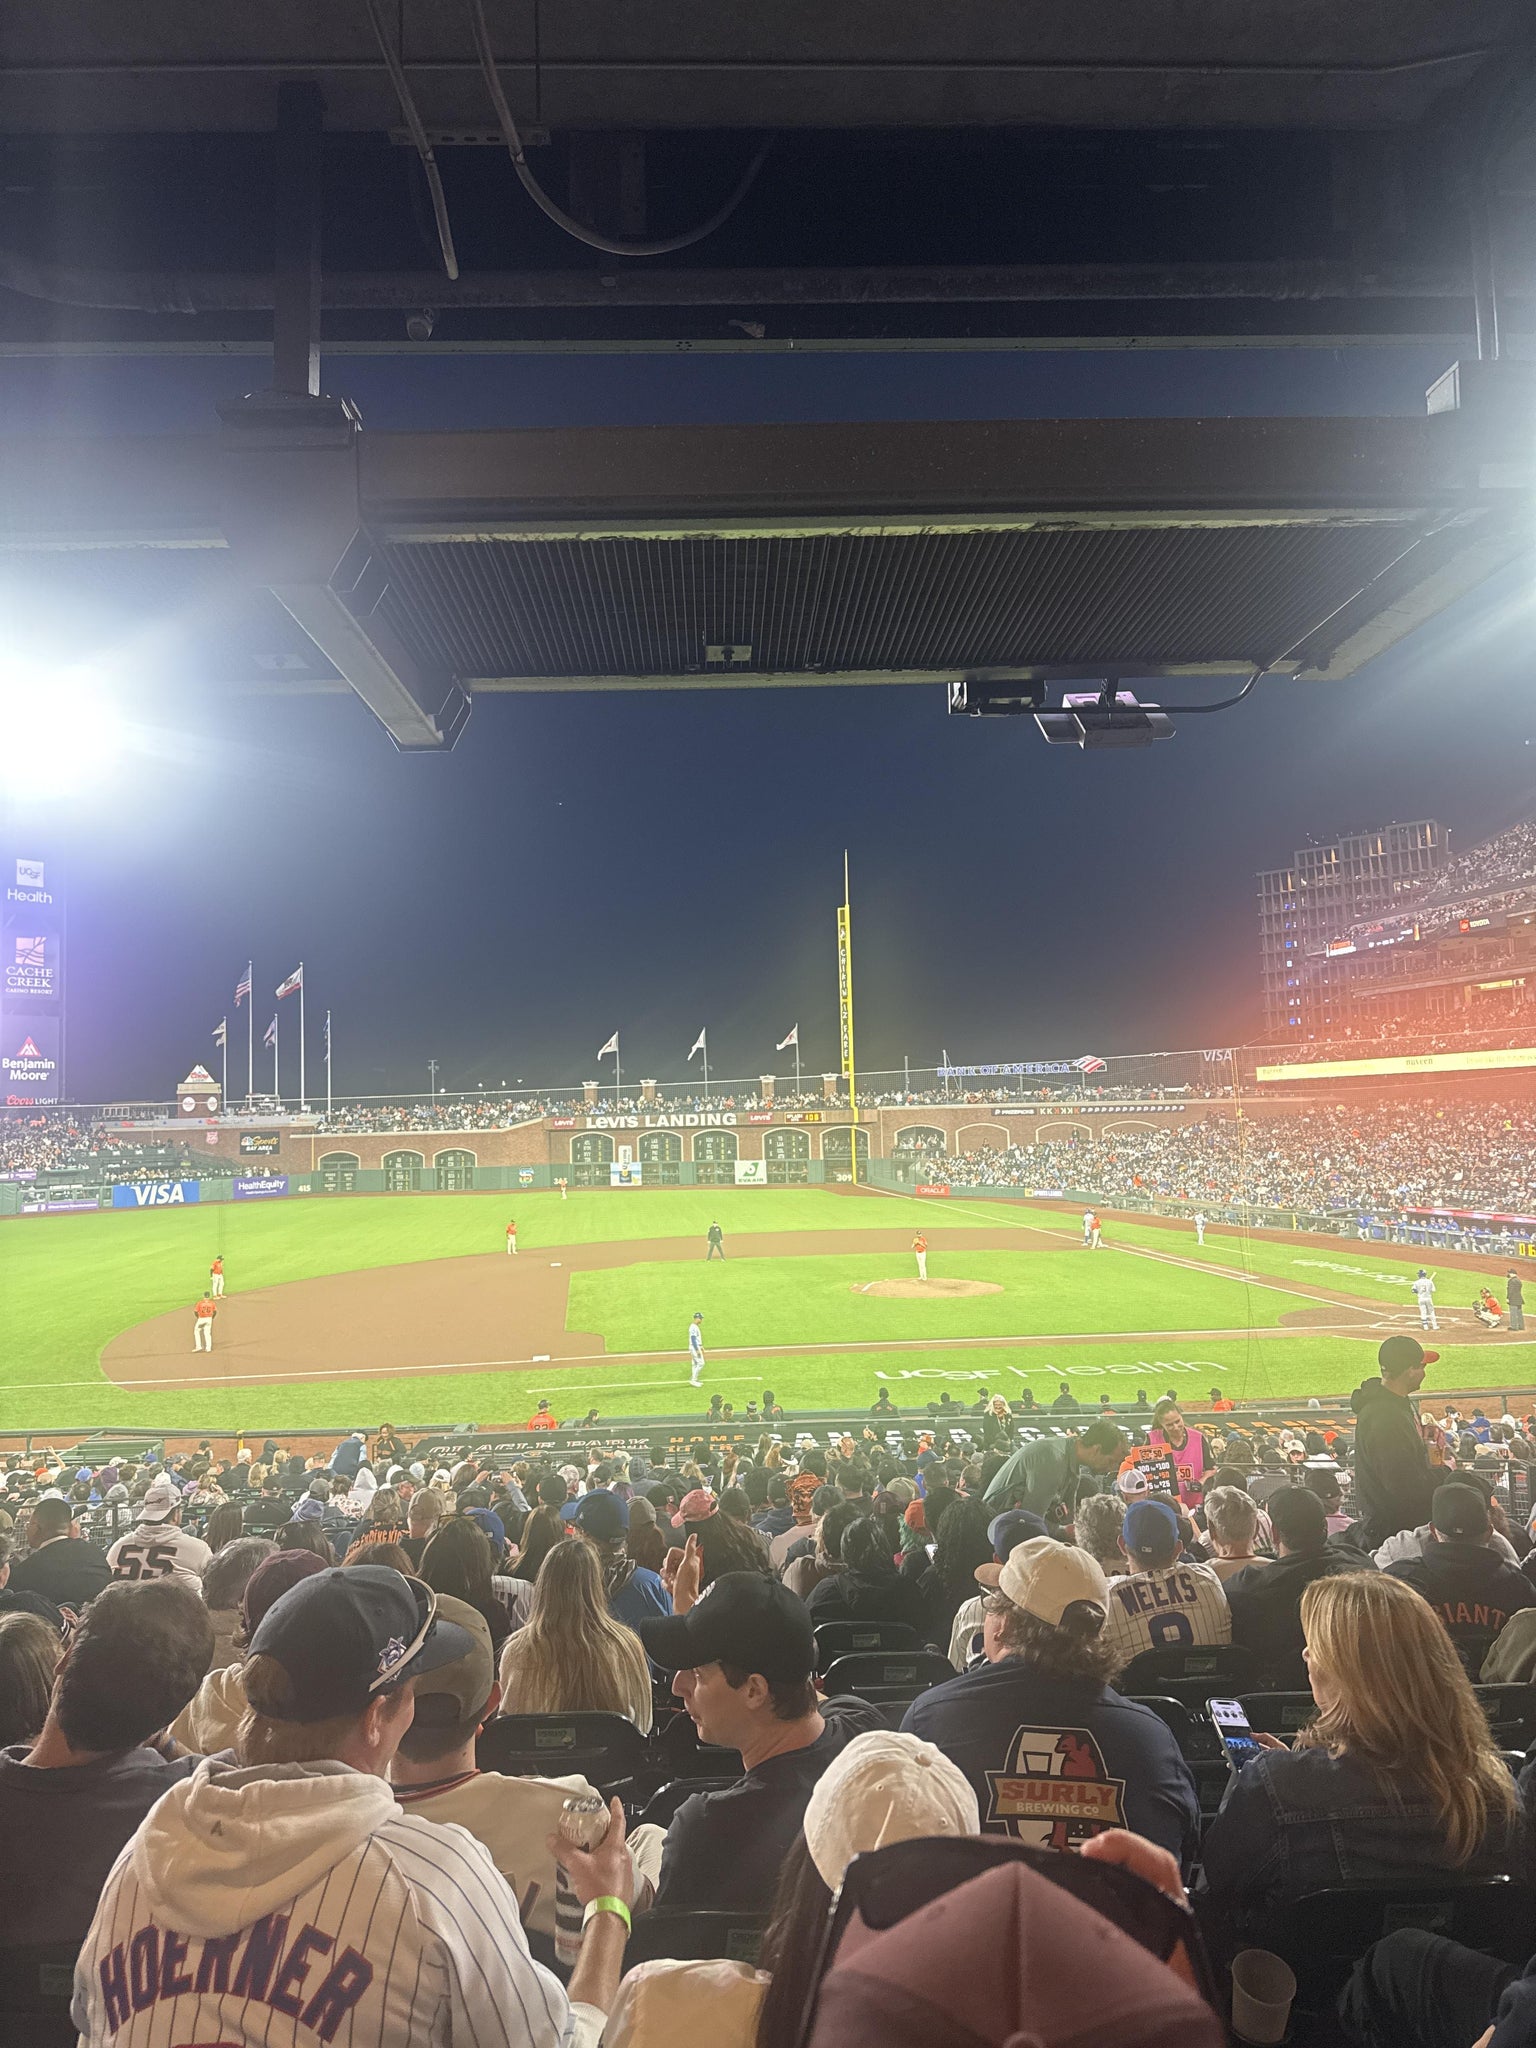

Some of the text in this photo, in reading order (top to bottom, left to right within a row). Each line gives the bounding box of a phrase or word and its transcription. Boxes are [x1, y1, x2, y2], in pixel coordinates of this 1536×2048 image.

[19, 867, 41, 880] UCSF
[7, 888, 53, 904] Health
[6, 966, 54, 978] CACHE
[7, 978, 52, 988] CREEK
[1203, 1050, 1233, 1061] VISA
[2, 1058, 55, 1071] Benjamin
[937, 1063, 1070, 1077] BANK OF AMERICA
[10, 1069, 48, 1080] Moore
[645, 1112, 737, 1127] LANDING
[836, 1173, 852, 1182] 309
[238, 1180, 286, 1190] HealthEquity
[130, 1183, 185, 1206] VISA
[874, 1360, 1228, 1380] UCSF Health
[1117, 1573, 1197, 1616] WEEKS
[1002, 1781, 1115, 1806] SURLY
[1016, 1802, 1080, 1815] BREWING
[100, 1912, 374, 2043] HOERNER
